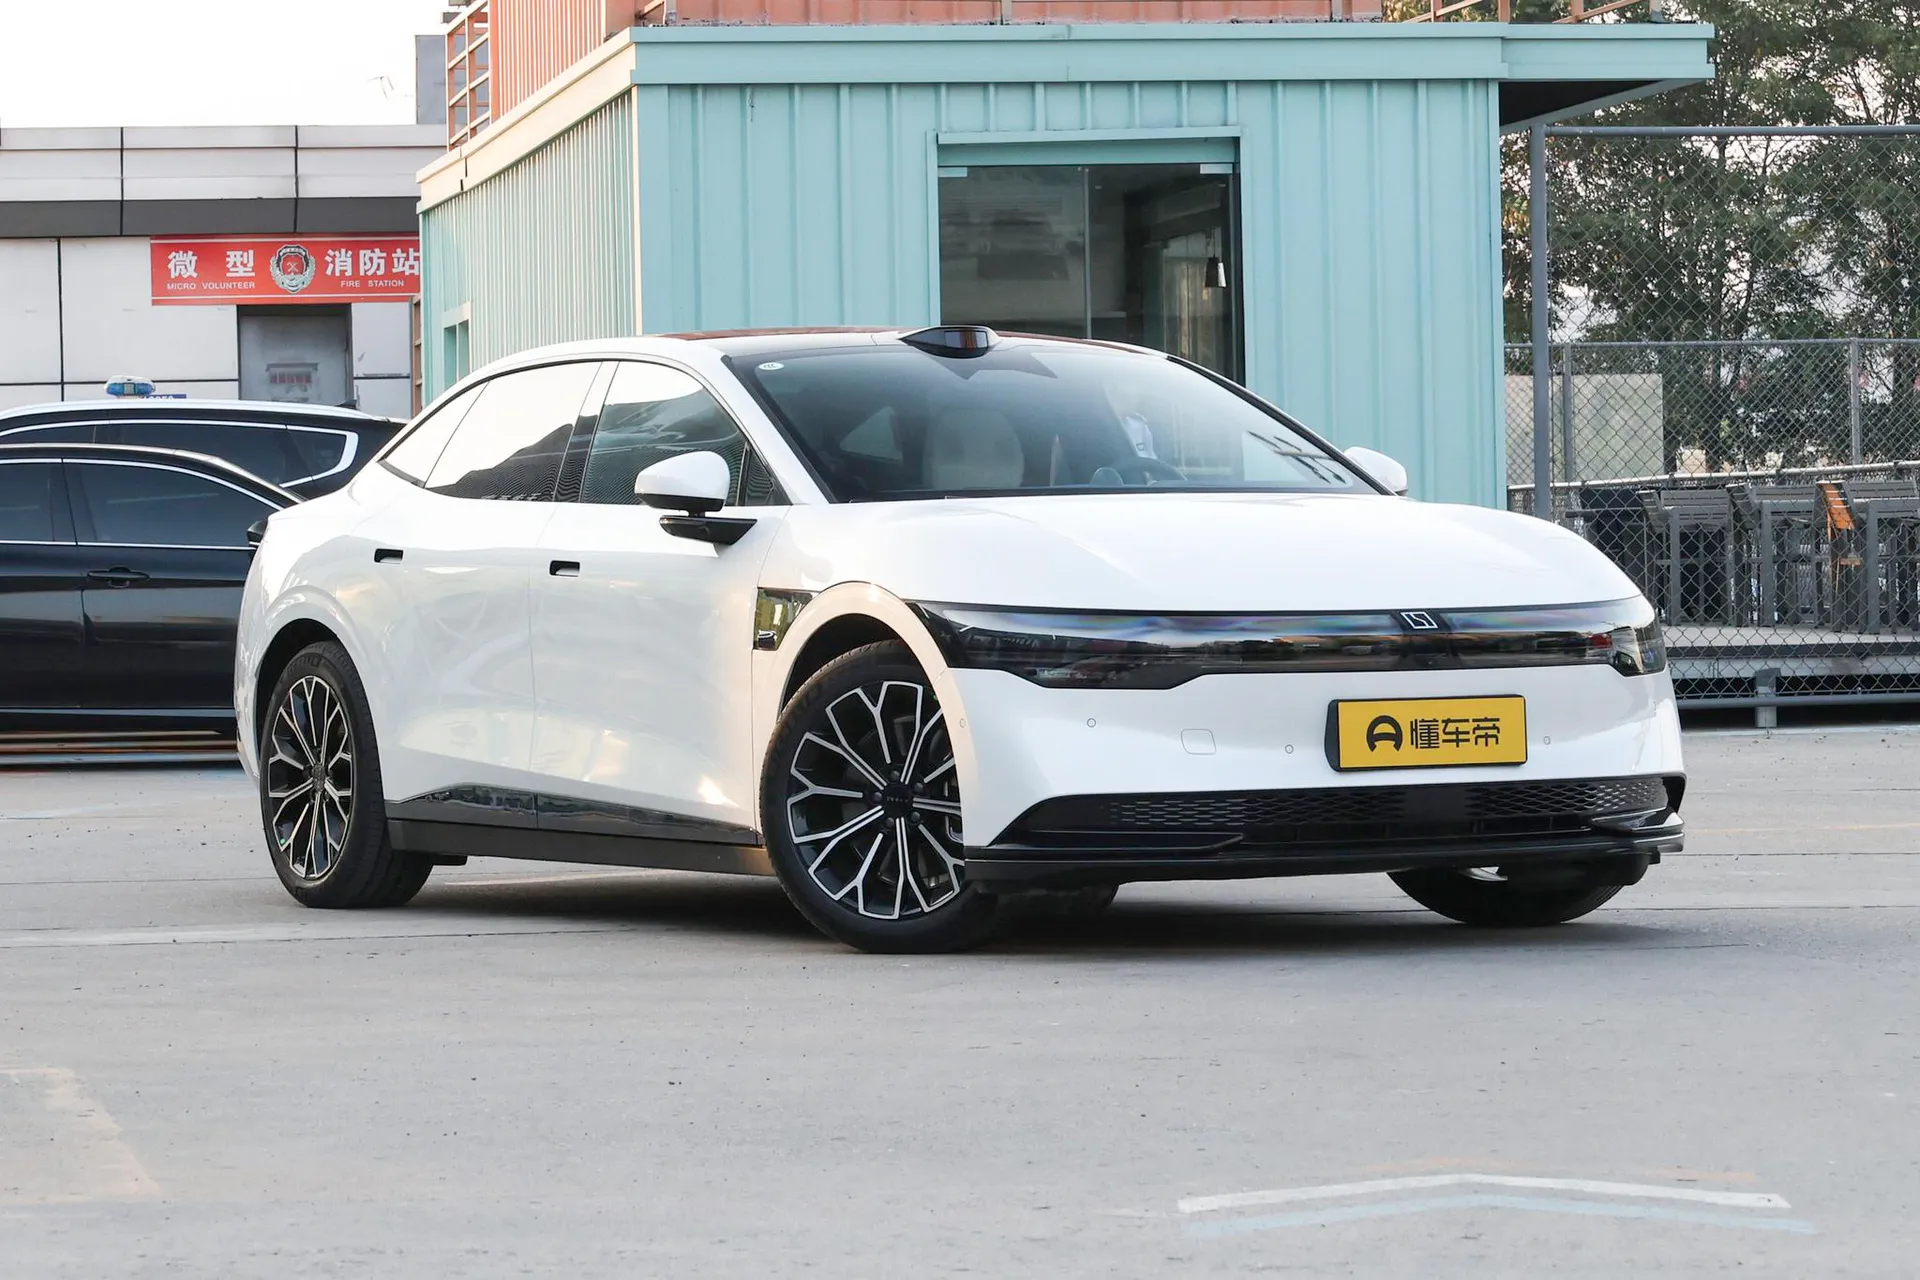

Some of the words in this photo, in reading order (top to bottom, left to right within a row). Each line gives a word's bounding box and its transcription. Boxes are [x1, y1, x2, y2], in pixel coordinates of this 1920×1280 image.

[167, 249, 256, 279] 微型
[324, 247, 420, 277] 消防站
[167, 282, 197, 290] MICRO
[202, 281, 256, 290] VOLUNTEER
[340, 280, 361, 288] FIRE
[367, 279, 405, 288] STATION
[1409, 716, 1501, 750] 懂车帝
